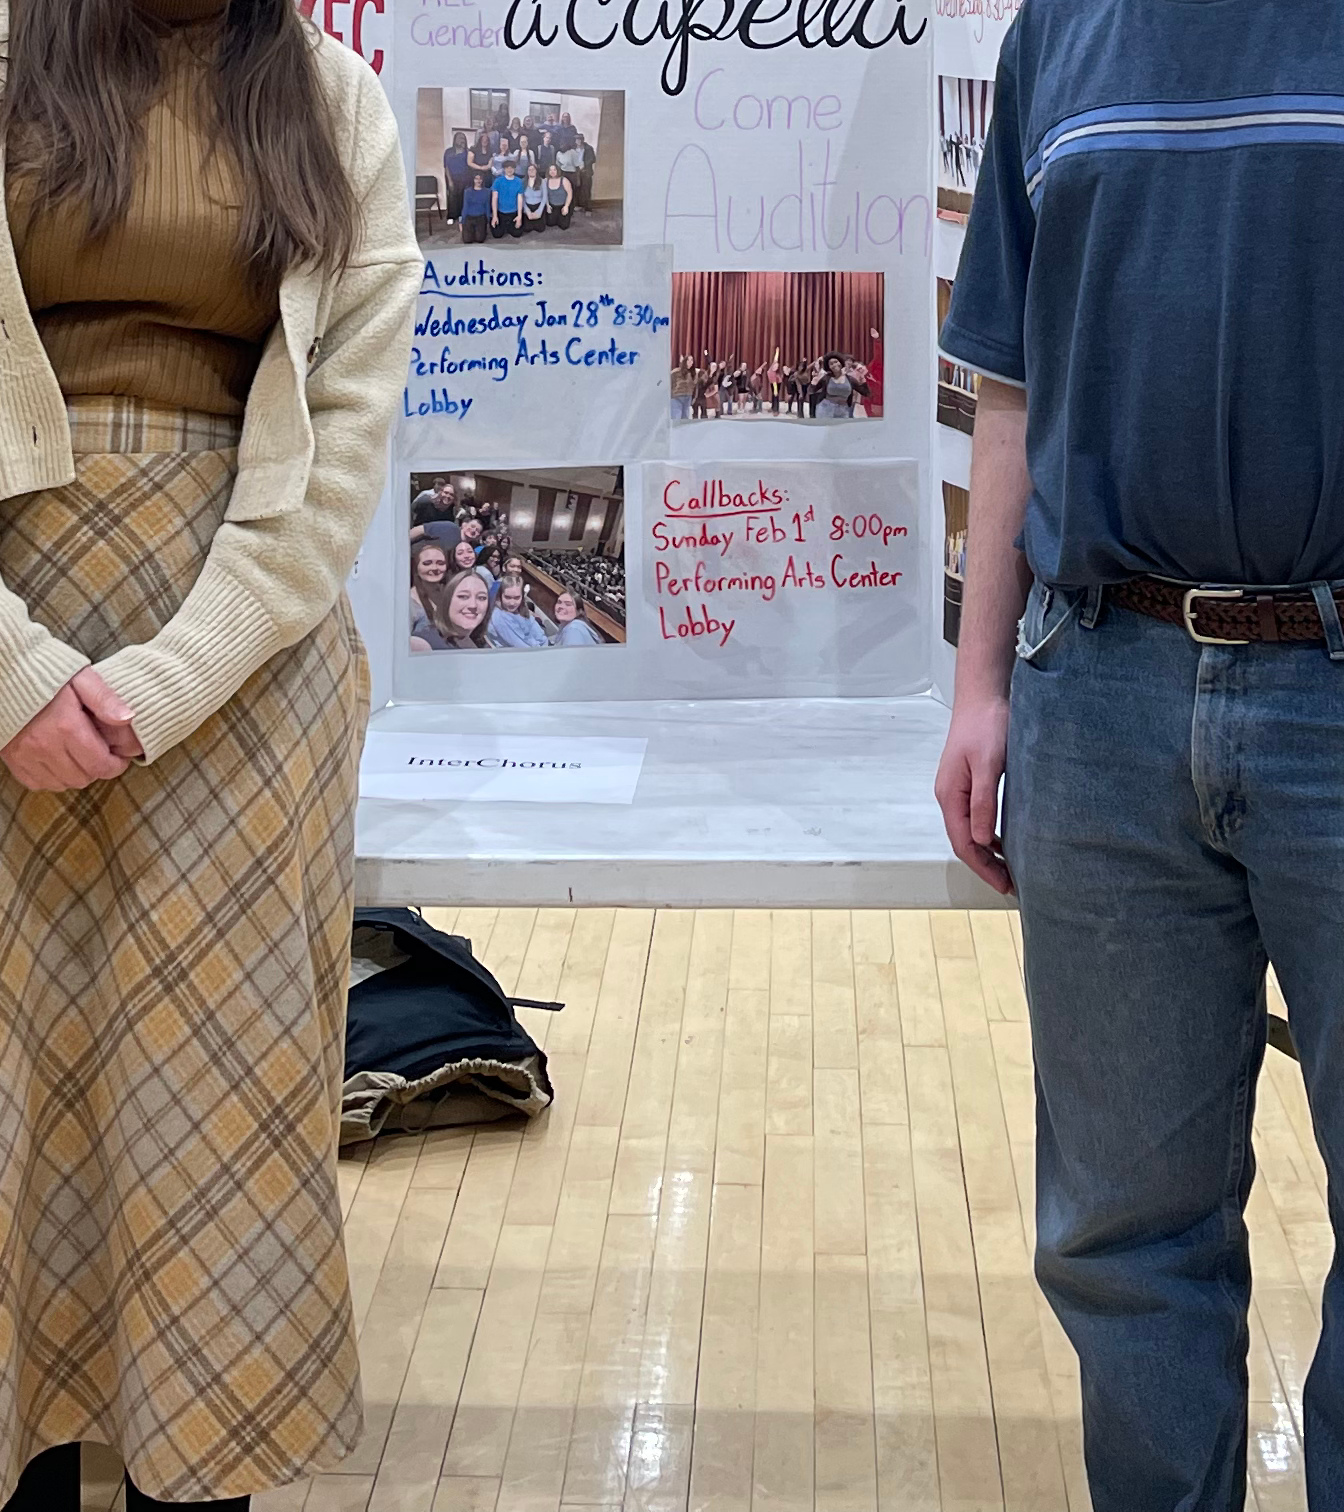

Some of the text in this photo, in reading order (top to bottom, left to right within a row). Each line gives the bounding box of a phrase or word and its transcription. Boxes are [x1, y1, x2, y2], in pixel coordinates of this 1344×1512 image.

[410, 10, 503, 49] Gender
[694, 68, 843, 131] Come
[663, 138, 933, 256] Audition
[423, 260, 544, 288] Auditions:
[414, 304, 528, 341] Wednesday
[535, 301, 567, 327] Jan
[514, 337, 560, 366] Arts
[565, 337, 640, 366] Center
[404, 387, 473, 419] Lobby
[664, 479, 790, 511] Callbacks:
[653, 505, 908, 556] Sunday Feb 1st 8:00pm
[656, 554, 903, 601] Performing Arts Center
[659, 604, 736, 647] Lobby
[407, 756, 582, 769] InterChorus
